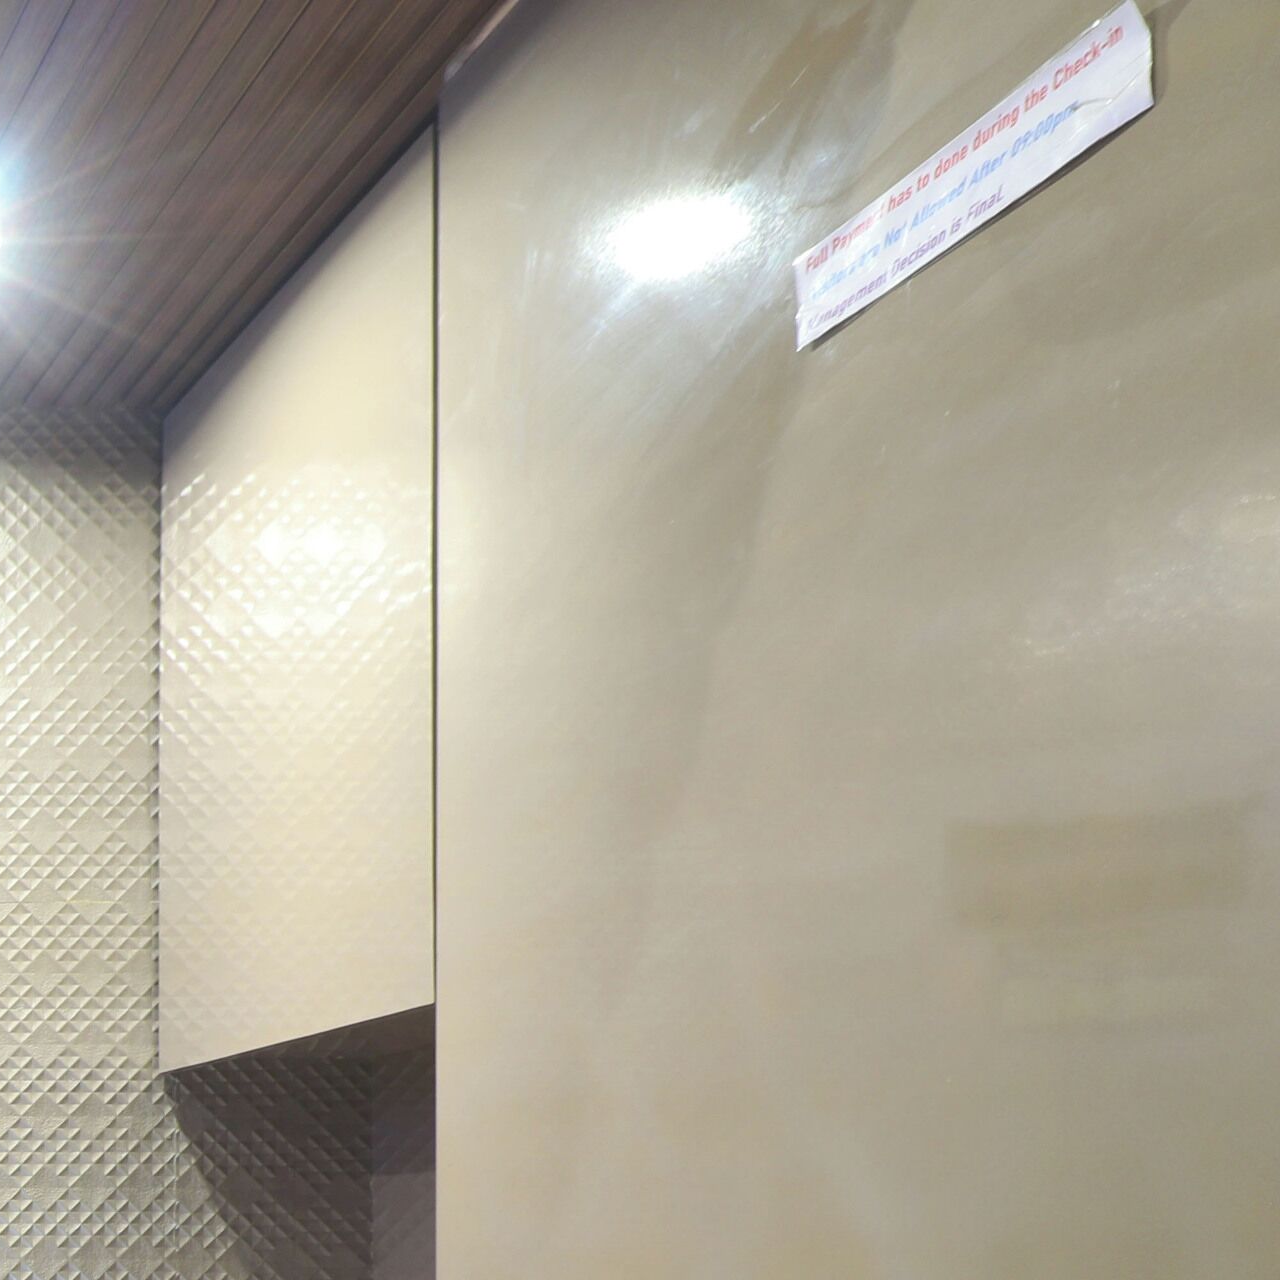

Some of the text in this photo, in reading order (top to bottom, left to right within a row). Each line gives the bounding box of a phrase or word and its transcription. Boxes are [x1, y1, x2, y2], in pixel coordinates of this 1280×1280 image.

[806, 245, 828, 273] Full
[888, 187, 913, 214] has
[916, 174, 931, 192] to
[934, 145, 968, 180] done
[973, 105, 1020, 151] during
[1024, 84, 1048, 113] the
[1052, 26, 1124, 90] Check-in
[969, 149, 1008, 188] After
[950, 215, 963, 236] is
